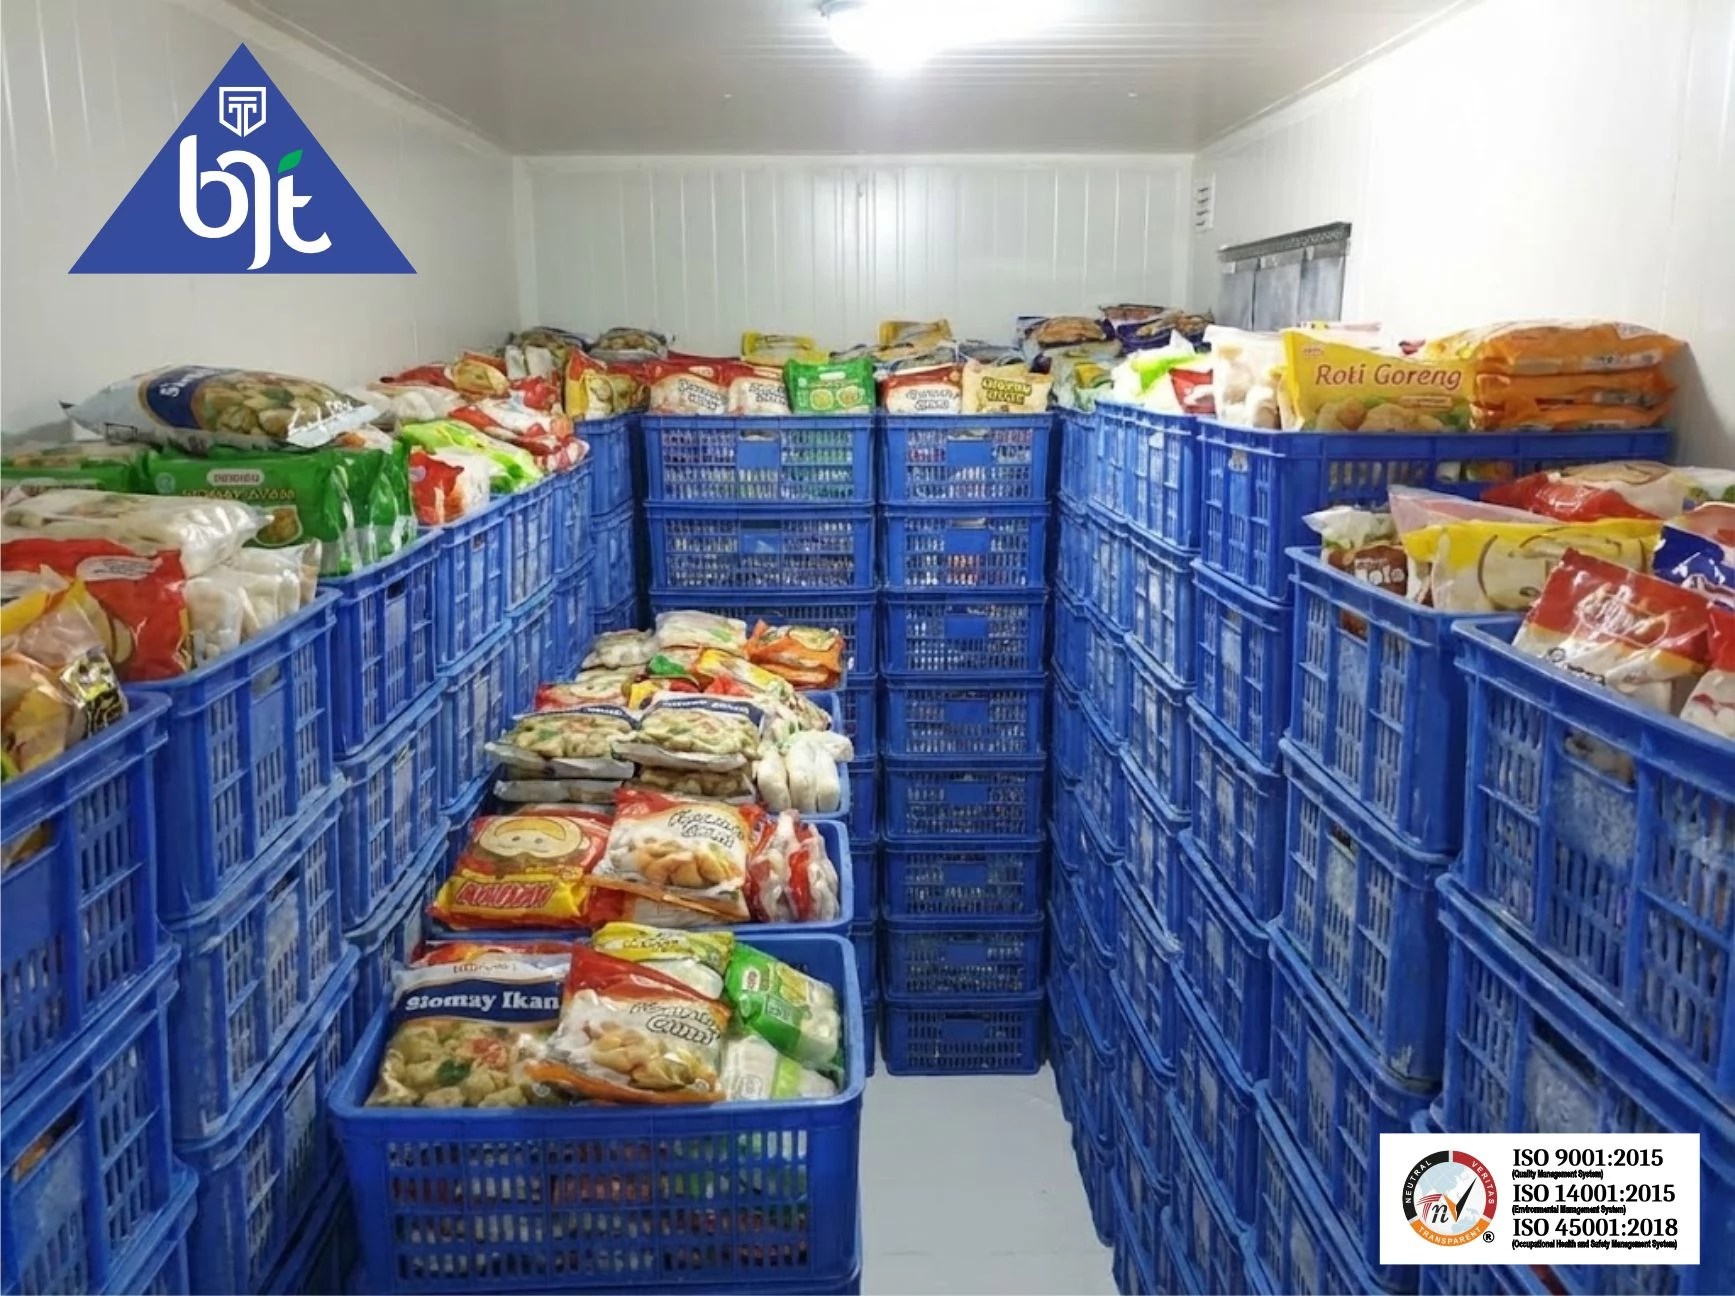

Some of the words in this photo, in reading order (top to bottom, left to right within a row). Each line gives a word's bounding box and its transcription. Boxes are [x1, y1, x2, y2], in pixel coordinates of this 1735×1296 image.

[1315, 363, 1367, 386] Roti
[1373, 363, 1462, 391] Goreng
[501, 991, 560, 1009] Ikan
